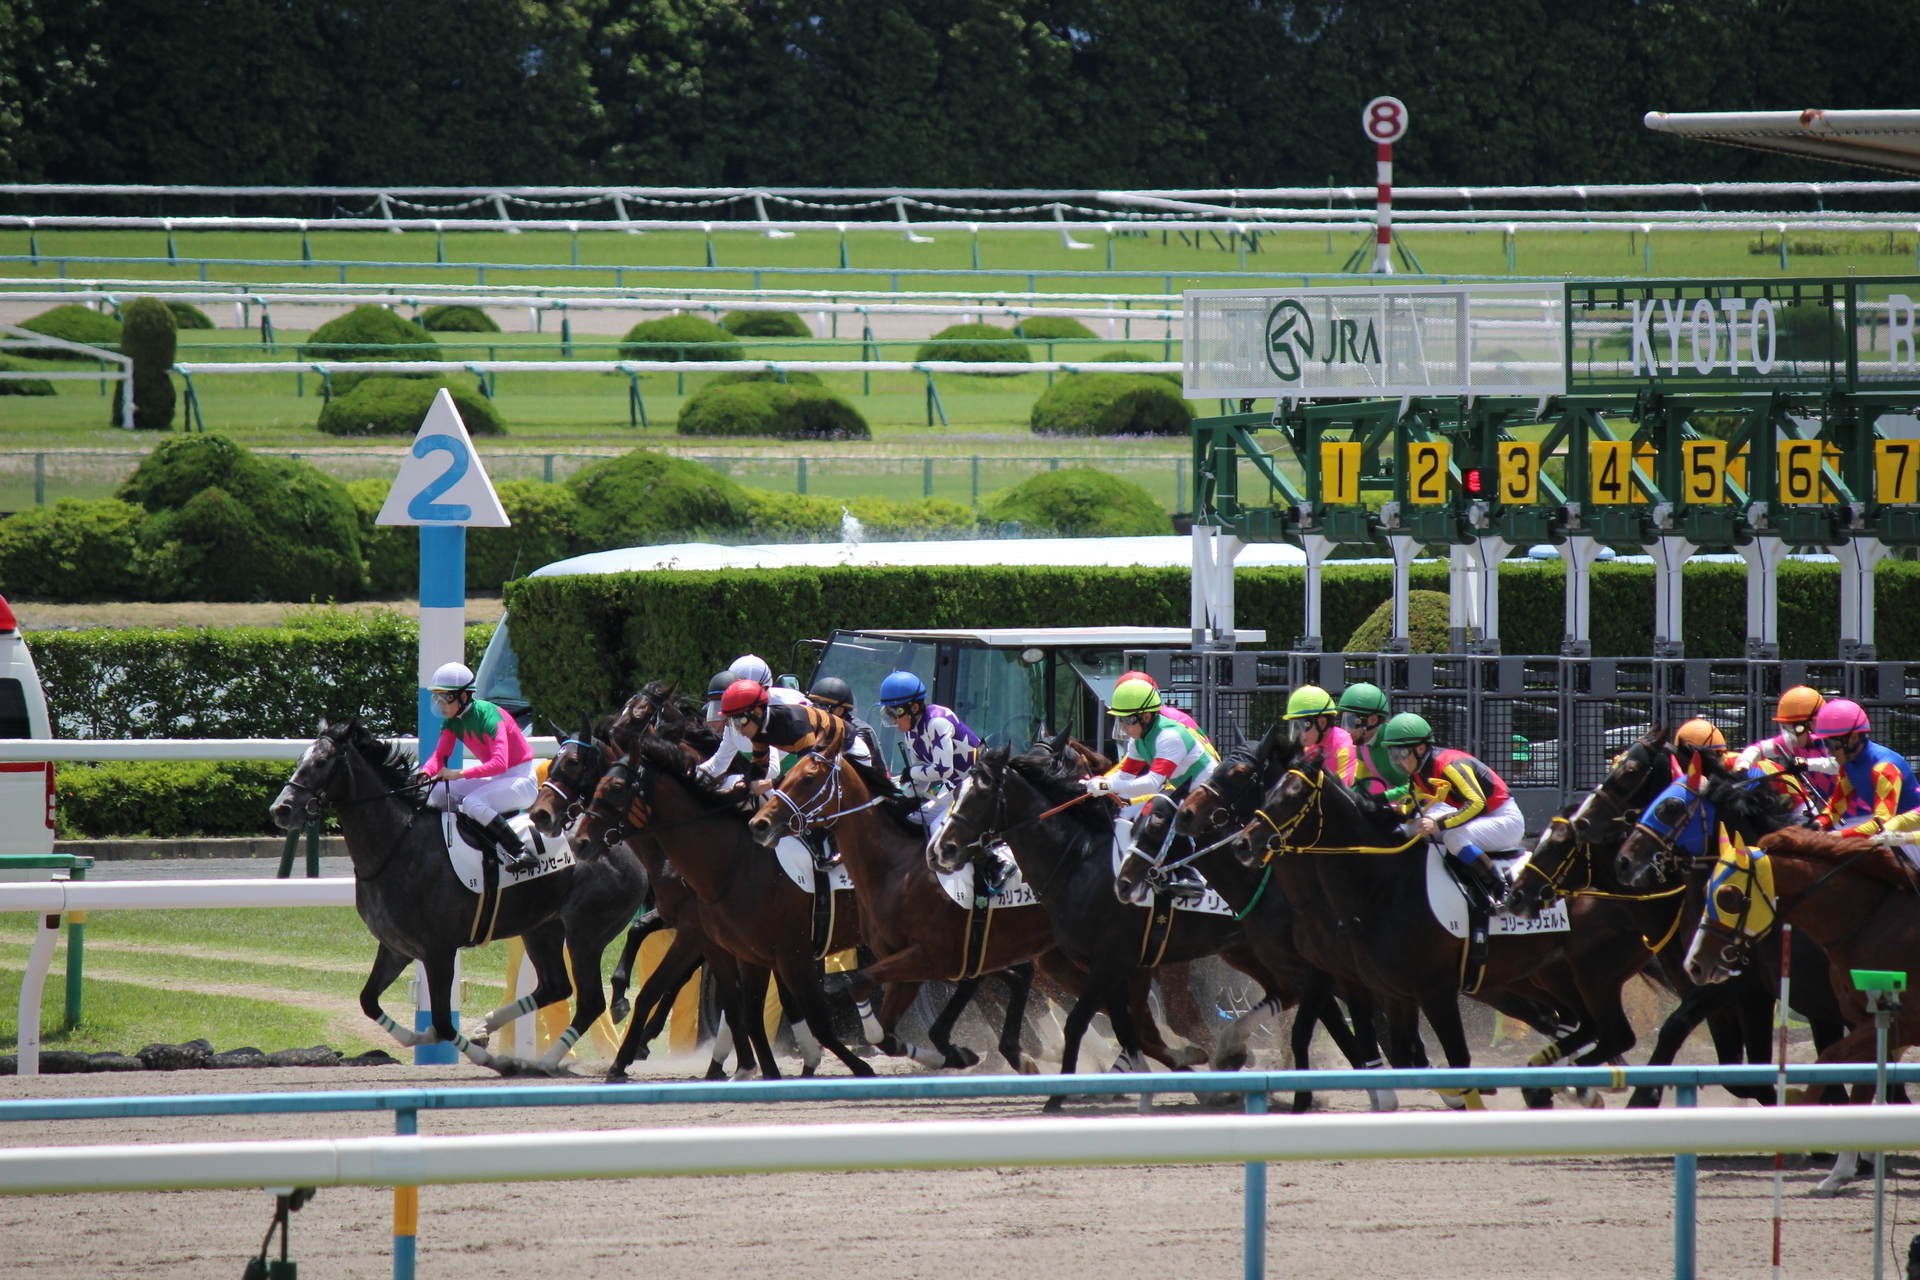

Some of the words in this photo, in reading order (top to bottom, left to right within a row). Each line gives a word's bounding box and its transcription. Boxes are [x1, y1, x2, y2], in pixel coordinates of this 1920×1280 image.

[1369, 101, 1401, 138] 8
[1322, 317, 1382, 364] JRA
[1632, 297, 1776, 377] KYOTO
[407, 433, 472, 521] 2
[1337, 447, 1344, 498] 1
[1418, 447, 1439, 498] 2
[1508, 446, 1530, 498] 3
[1599, 446, 1622, 500] 4
[1693, 446, 1716, 498] 5
[1788, 445, 1812, 498] 6
[1885, 444, 1909, 499] 7
